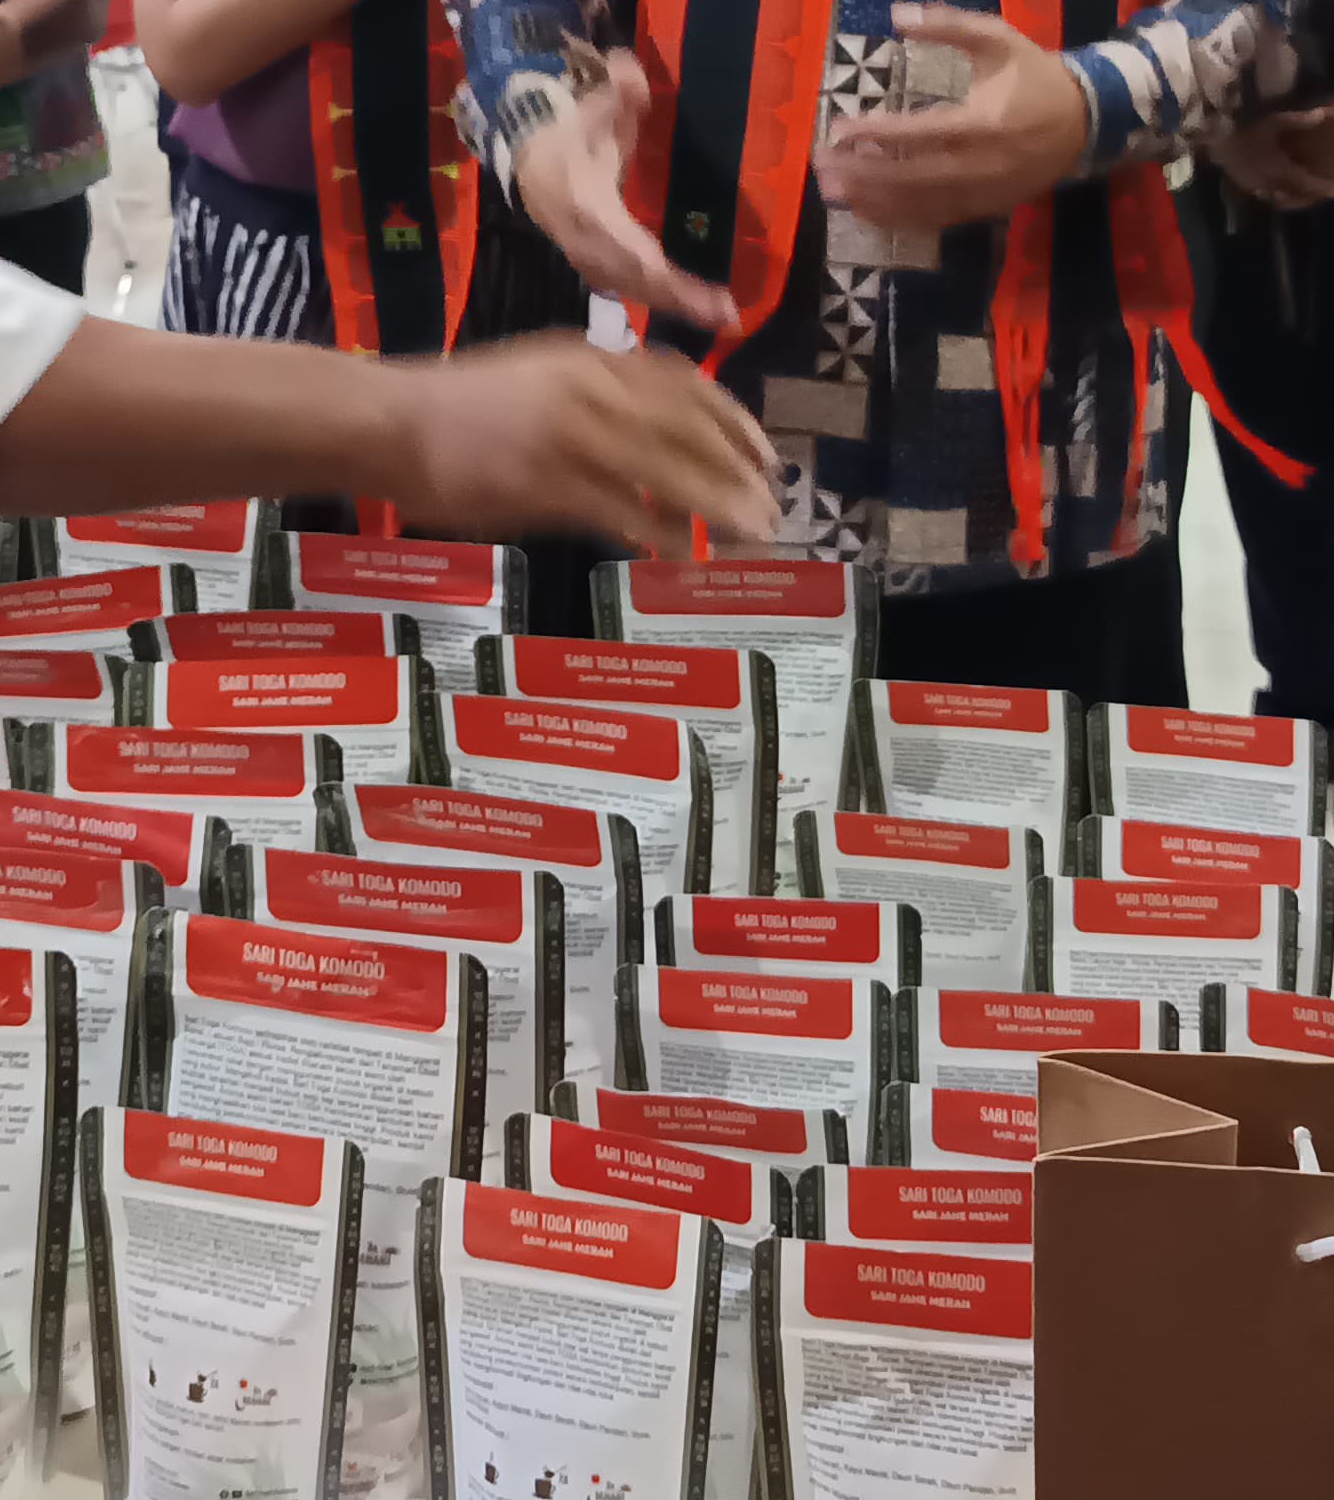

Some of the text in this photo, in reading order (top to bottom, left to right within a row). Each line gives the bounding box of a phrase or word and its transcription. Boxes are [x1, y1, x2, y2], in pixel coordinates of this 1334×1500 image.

[505, 712, 627, 738] SARI TOGA KOMODO
[13, 807, 136, 839] SARI TOGA KOMODO
[413, 798, 542, 826] SARI TOGA KOMODO
[1161, 836, 1259, 857] SARI TOGA KOMODO
[323, 870, 461, 897] SARI TOGA KOMODO
[1116, 892, 1217, 909] SARI TOGA KOMODO
[735, 914, 836, 929] SARI TOGA KOMODO
[243, 943, 384, 979] SARI TOGA KOMODO
[702, 983, 807, 1003] SARI TOGA KOMODO
[984, 1004, 1093, 1022] SARI TOGA KOMODO
[1293, 1007, 1317, 1022] SARI
[980, 1107, 1007, 1123] SARI
[168, 1131, 277, 1161] SARI TOGA KOMODO
[595, 1144, 704, 1178] SARI TOGA KOMODO
[899, 1187, 1021, 1204] SARI TOGA KOMODO
[511, 1209, 627, 1240] SARI TOGA KOMODO
[858, 1264, 985, 1291] SARI TOGA KOMODO
